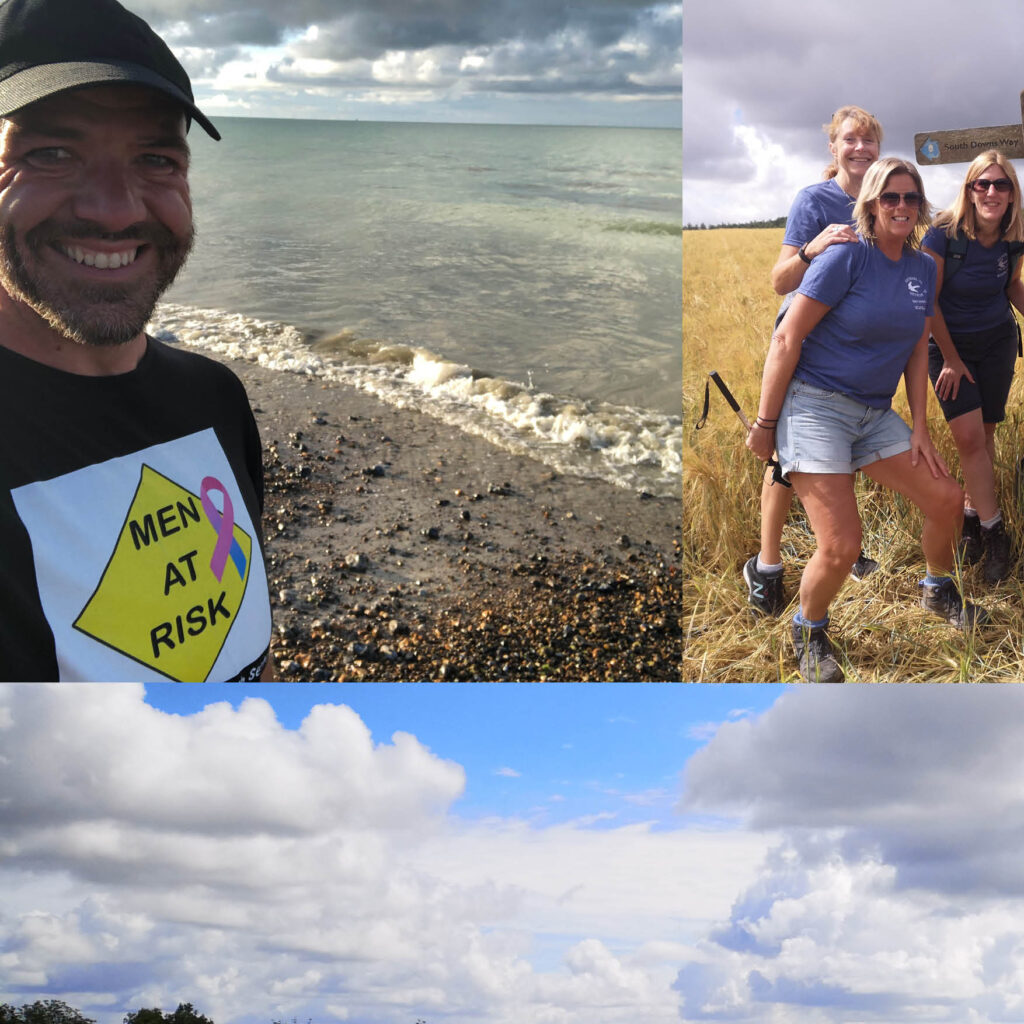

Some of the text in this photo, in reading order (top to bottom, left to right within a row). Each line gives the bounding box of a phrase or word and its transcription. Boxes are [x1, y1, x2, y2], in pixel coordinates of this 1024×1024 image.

[944, 138, 1019, 151] South Downs Way
[129, 496, 201, 551] MEN
[163, 550, 199, 596] AT
[150, 591, 231, 659] RISK
